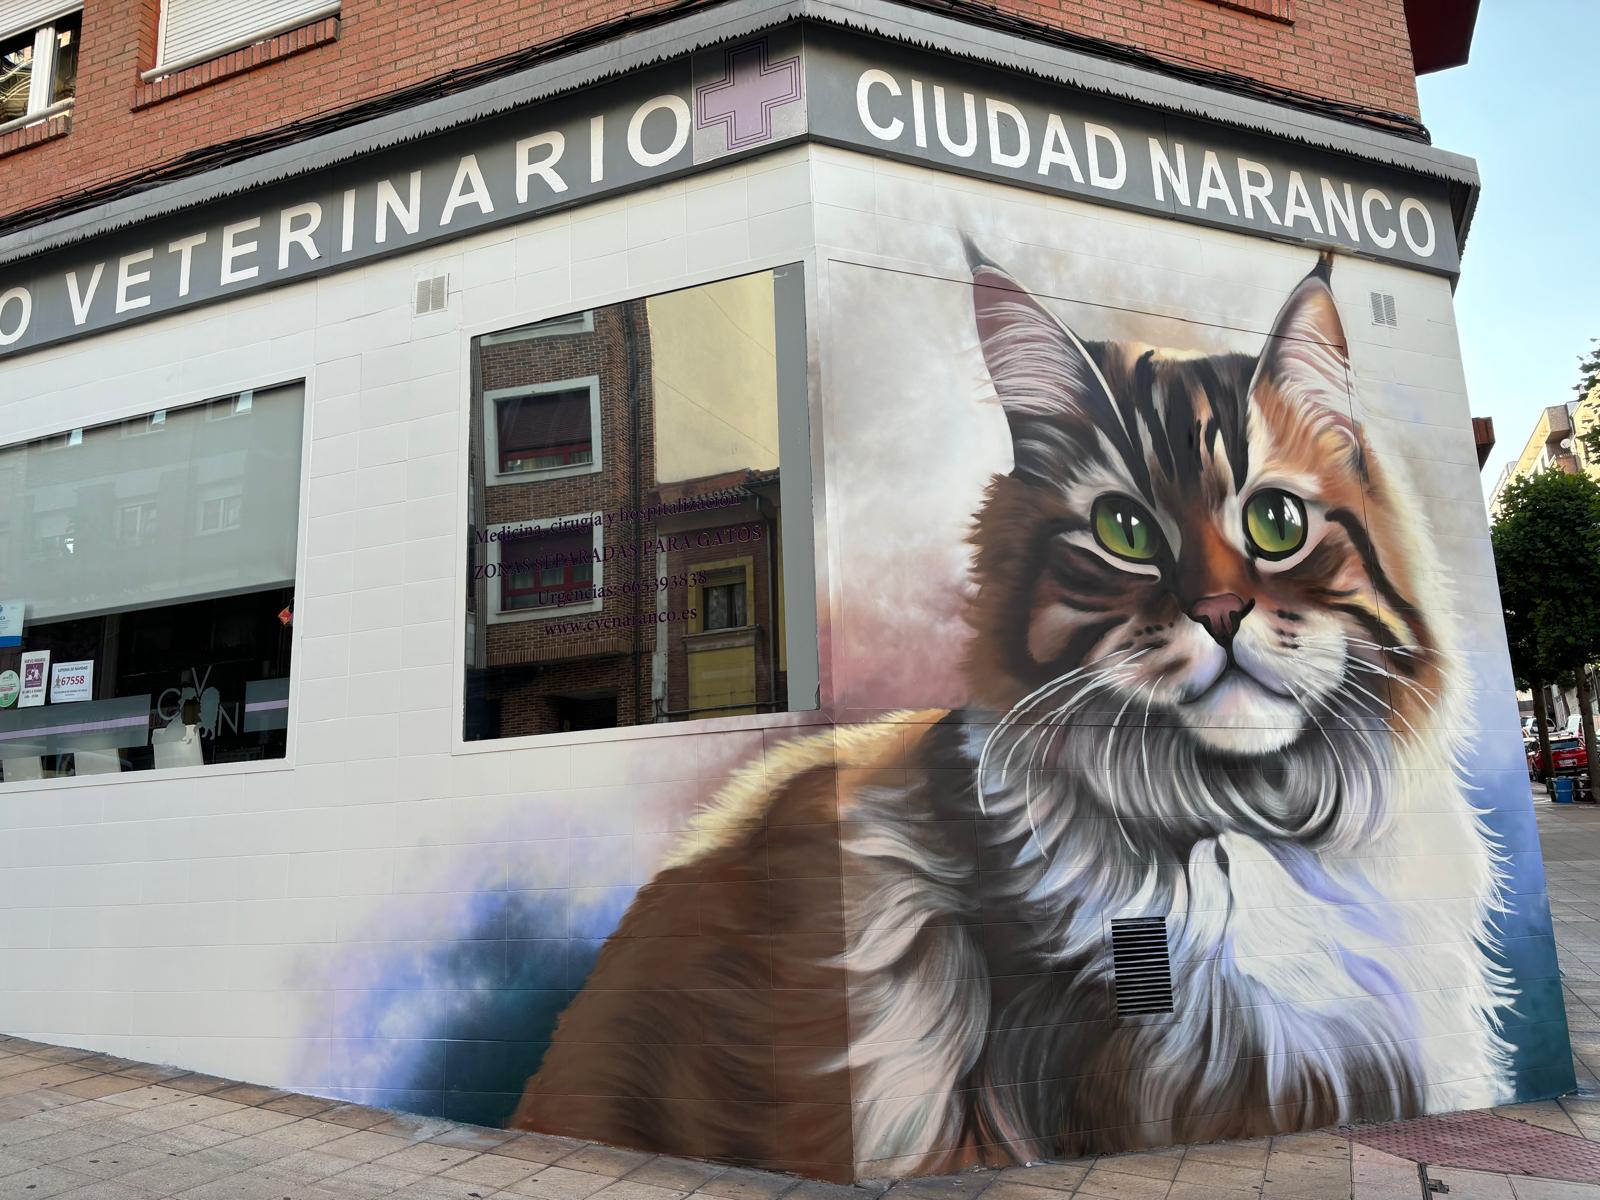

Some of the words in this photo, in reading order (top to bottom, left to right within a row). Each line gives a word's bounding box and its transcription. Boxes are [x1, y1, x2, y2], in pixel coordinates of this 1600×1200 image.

[856, 68, 1128, 191] CIUDAD
[1150, 137, 1437, 258] NARANCO
[65, 94, 691, 326] VETERINARIO
[550, 511, 602, 535] cirugía
[607, 513, 616, 527] y
[619, 493, 741, 524] hospitalización
[473, 556, 531, 580] ZONAS
[643, 534, 692, 555] PARA
[697, 524, 763, 549] GATOS
[538, 584, 618, 608] Urgencias:
[61, 675, 85, 686] 67558
[217, 702, 239, 736] N
